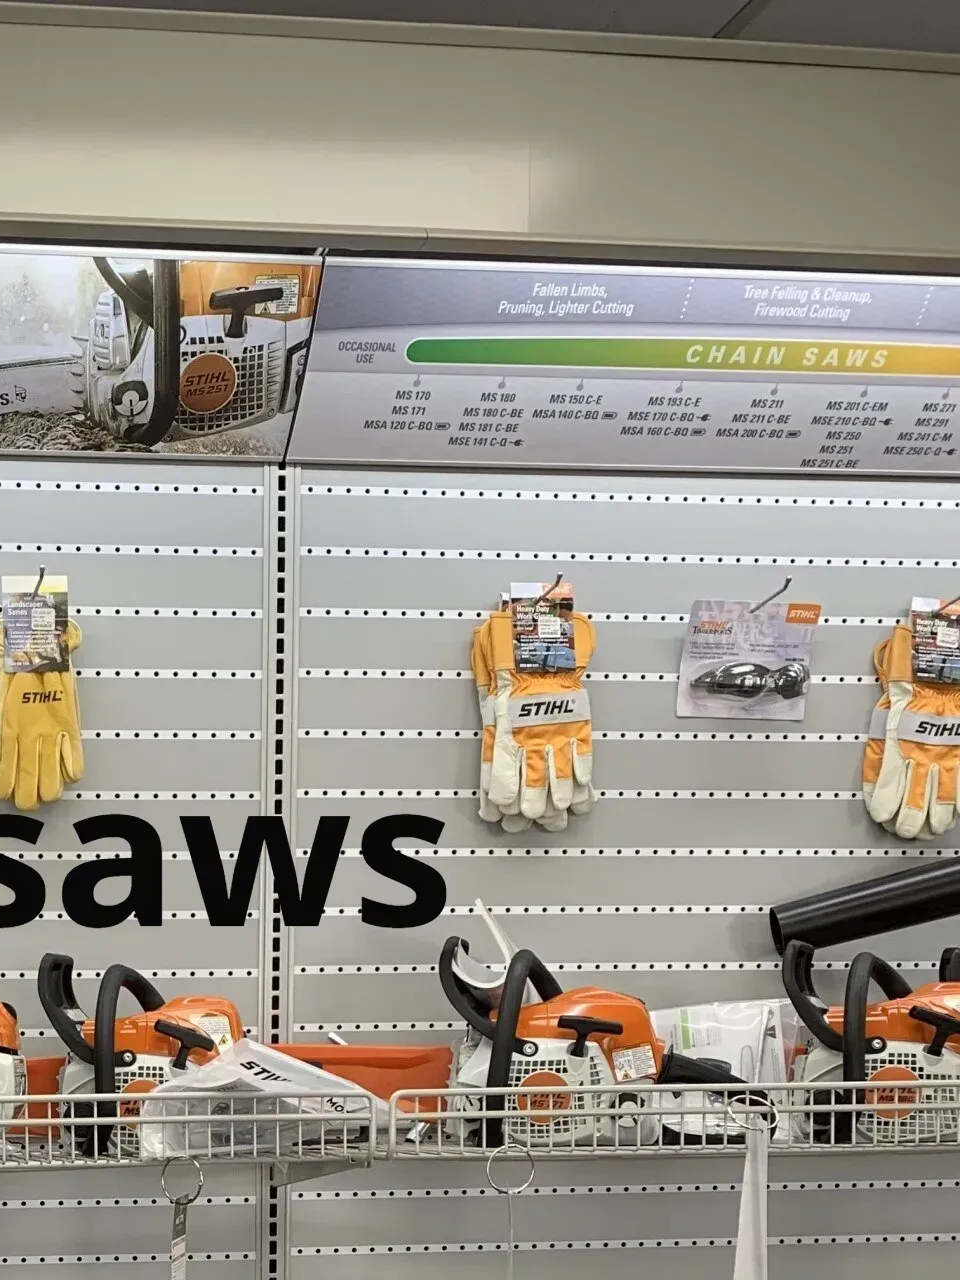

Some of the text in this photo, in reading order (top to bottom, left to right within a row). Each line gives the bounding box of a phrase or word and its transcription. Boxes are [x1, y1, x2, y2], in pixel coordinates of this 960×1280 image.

[532, 283, 608, 298] Fallen Limbs,
[744, 285, 872, 304] Tree Felling & Cleanup,
[498, 300, 634, 317] Pruning, Lighter Cutting
[755, 303, 850, 321] Firewood Cutting
[338, 341, 396, 353] OCCASIONAL
[355, 353, 374, 364] USE
[686, 344, 888, 368] CHAIN SAWS
[183, 371, 230, 388] STIHL
[395, 390, 431, 401] MS 170
[480, 392, 516, 403] MS 180
[549, 394, 603, 405] MS 150 C-E
[648, 397, 701, 407] MS 193 C-E
[750, 399, 784, 409] MS 211
[826, 401, 889, 412] MS 201 C-EM
[922, 402, 956, 413] MS 271
[391, 405, 425, 416] MS 171
[463, 408, 524, 418] MS 180 C-BE
[532, 409, 598, 420] MSA 140 C-BQ
[627, 412, 694, 423] MSE 170 C-BQ
[731, 413, 791, 424] MS 211 C-BE
[914, 417, 949, 428] MS 291
[363, 420, 434, 431] MSA 120 C-BQ
[458, 423, 519, 433] MS 181 C-BE
[825, 431, 860, 441] MS 250
[897, 431, 952, 442] MS 241 C-M
[819, 445, 853, 456] MS 251
[800, 459, 860, 469] MS 251 C-BE
[789, 610, 817, 618] STIHL
[22, 692, 62, 704] STIHL
[518, 700, 573, 717] STIHL
